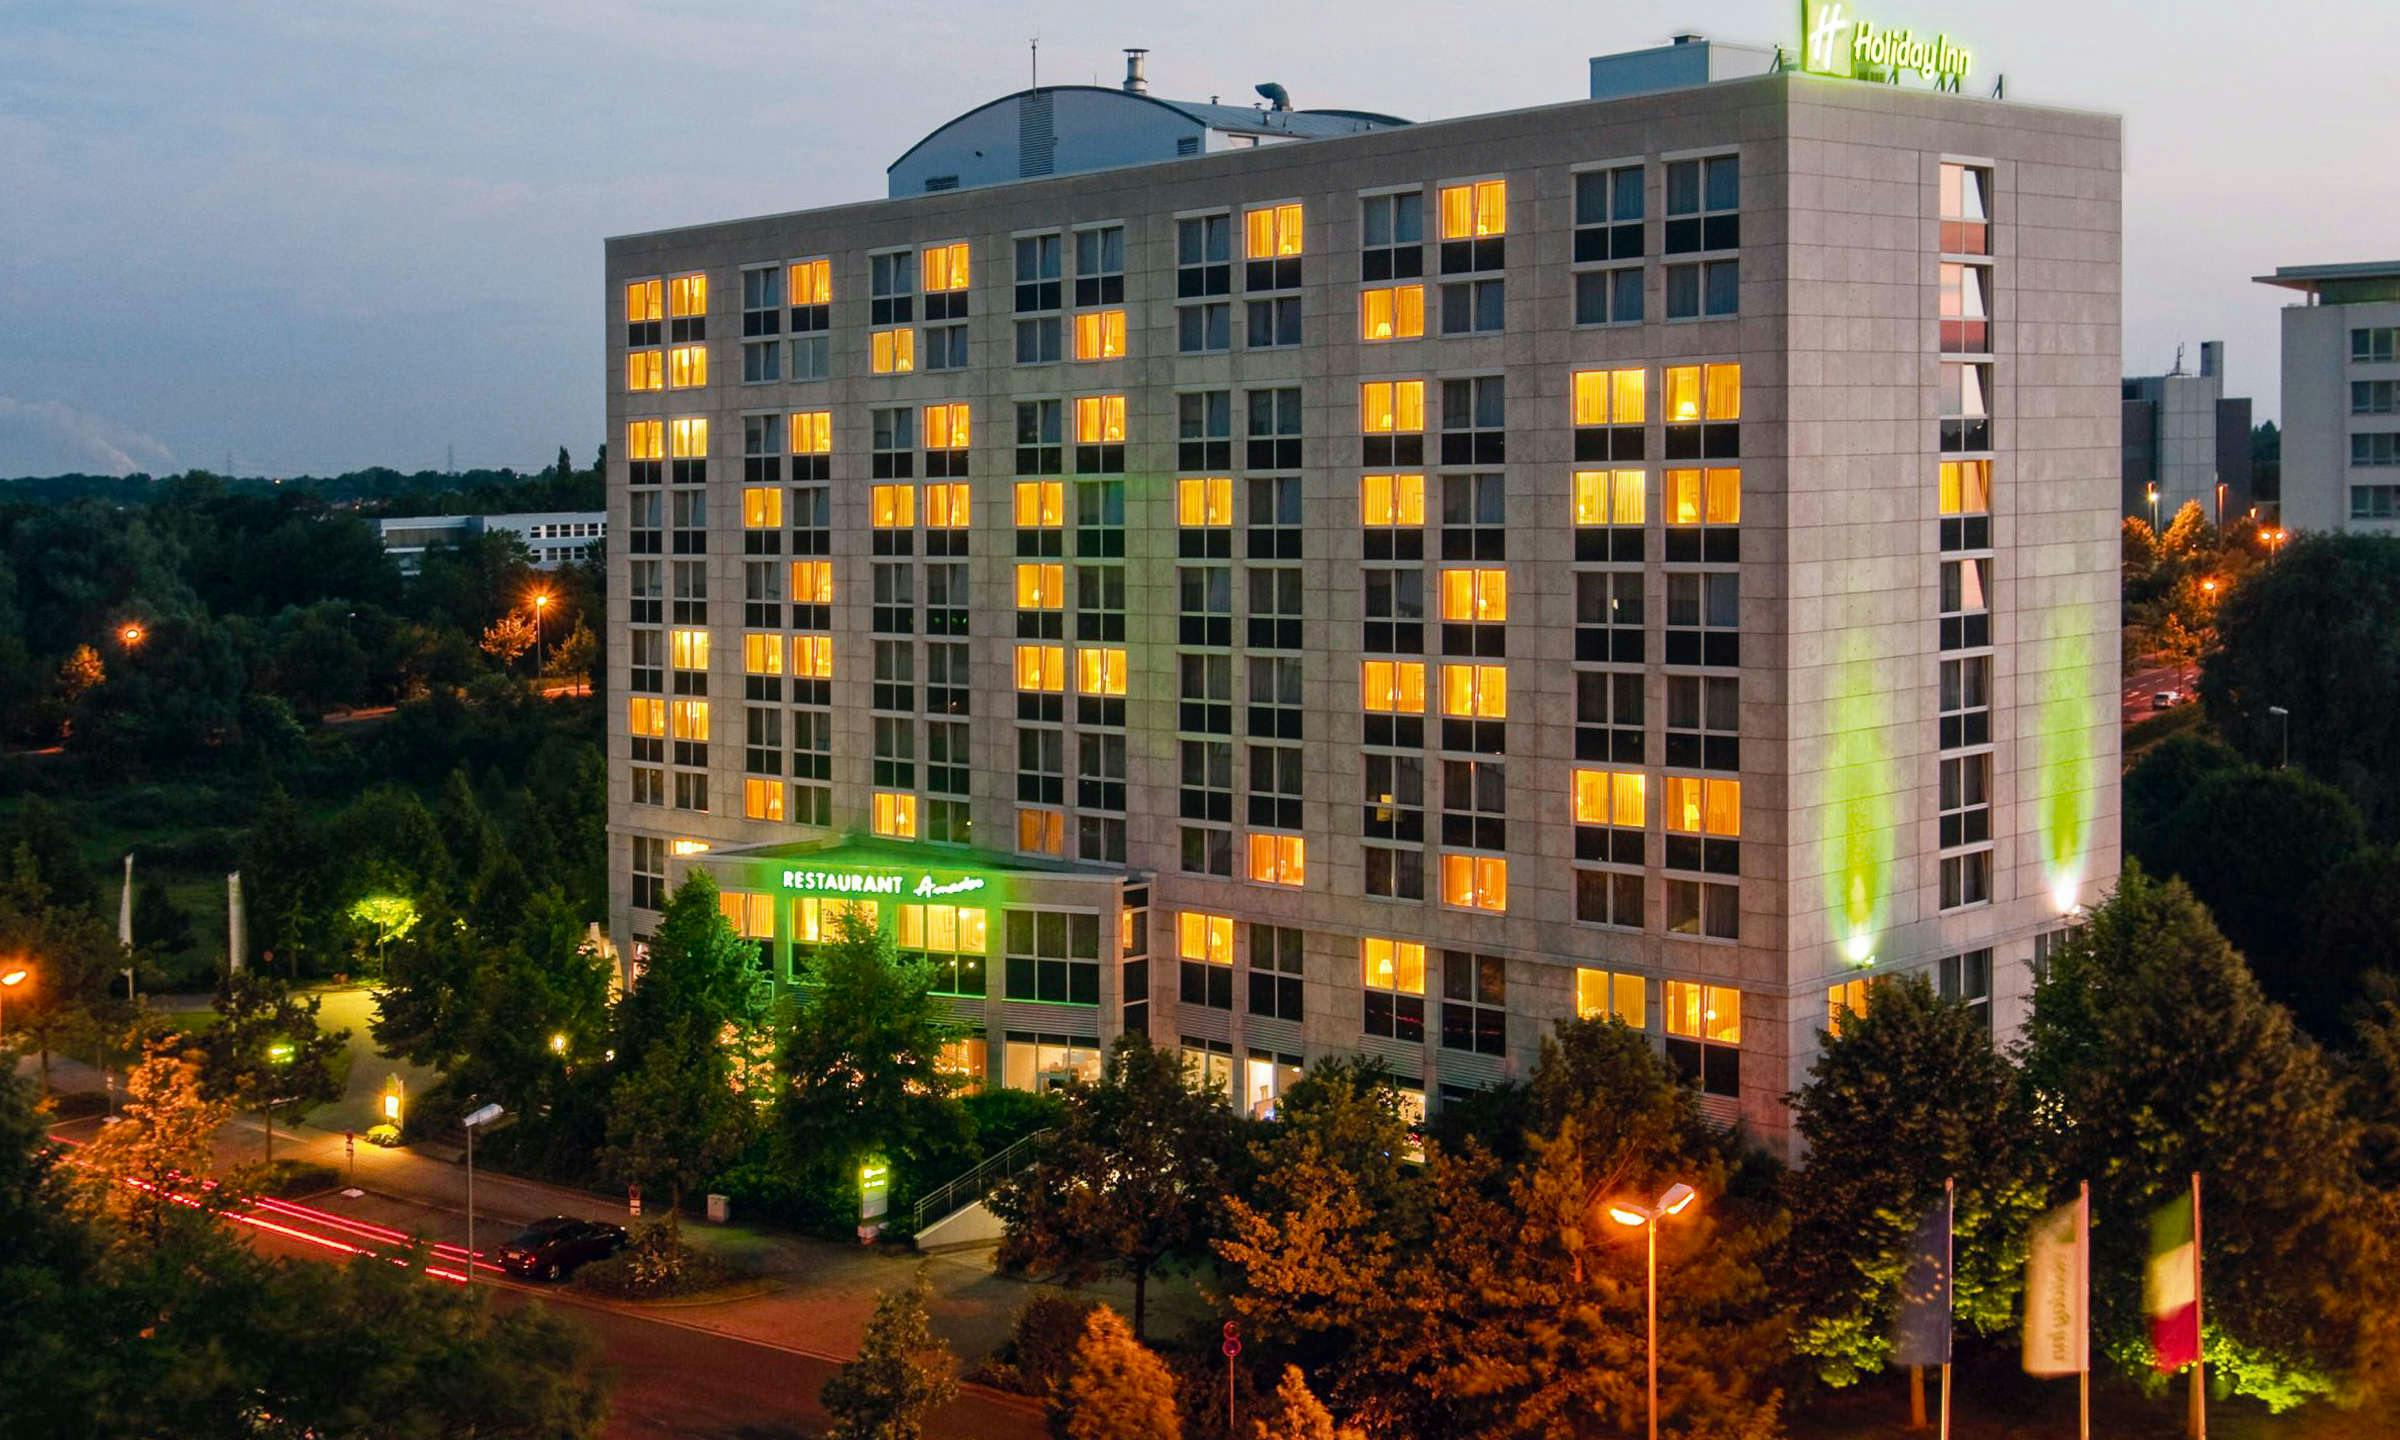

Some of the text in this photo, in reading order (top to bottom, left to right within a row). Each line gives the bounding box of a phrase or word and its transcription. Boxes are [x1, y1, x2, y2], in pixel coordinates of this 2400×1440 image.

[1855, 21, 1970, 80] Holiday Inn
[783, 871, 903, 894] RESTAURANT
